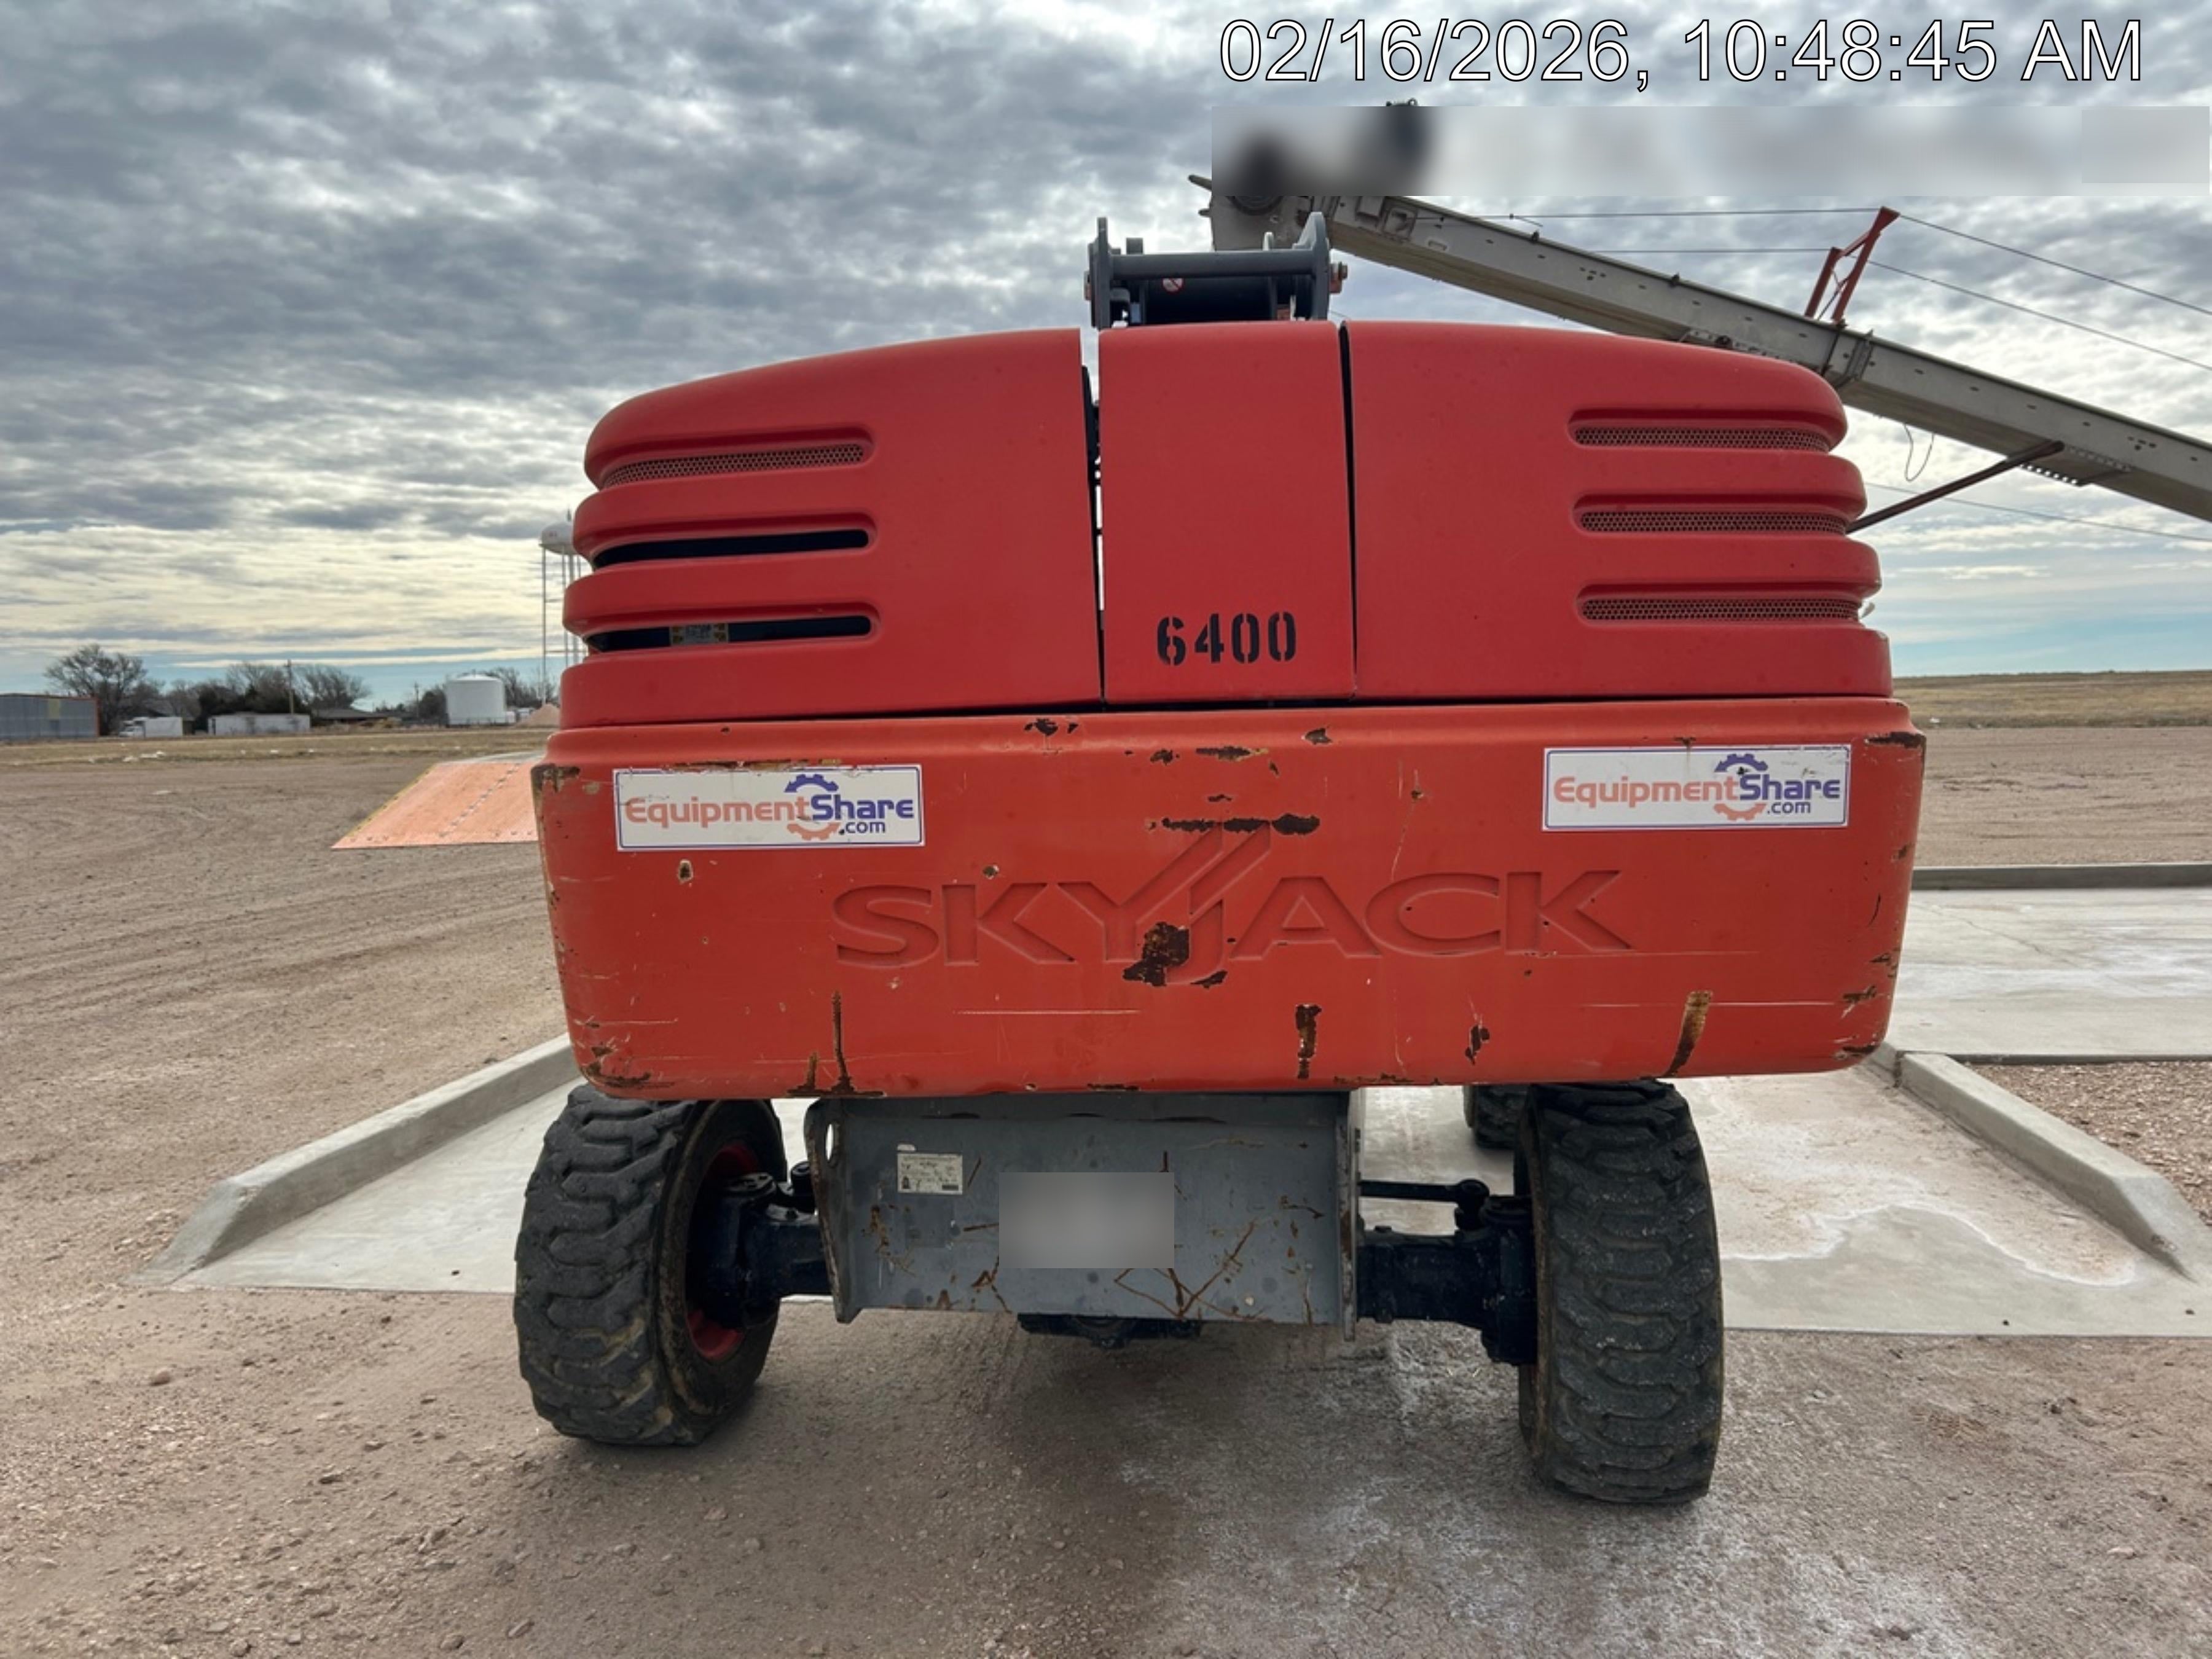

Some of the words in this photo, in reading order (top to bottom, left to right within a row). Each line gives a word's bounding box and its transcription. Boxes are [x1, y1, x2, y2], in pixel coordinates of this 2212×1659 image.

[1157, 612, 1296, 666] 6400
[1554, 774, 1840, 808] EquipmentShare
[1767, 801, 1811, 814] .com
[625, 794, 914, 828] EquipmentShare
[839, 823, 885, 835] .com
[832, 823, 1634, 985] SKYJACK
